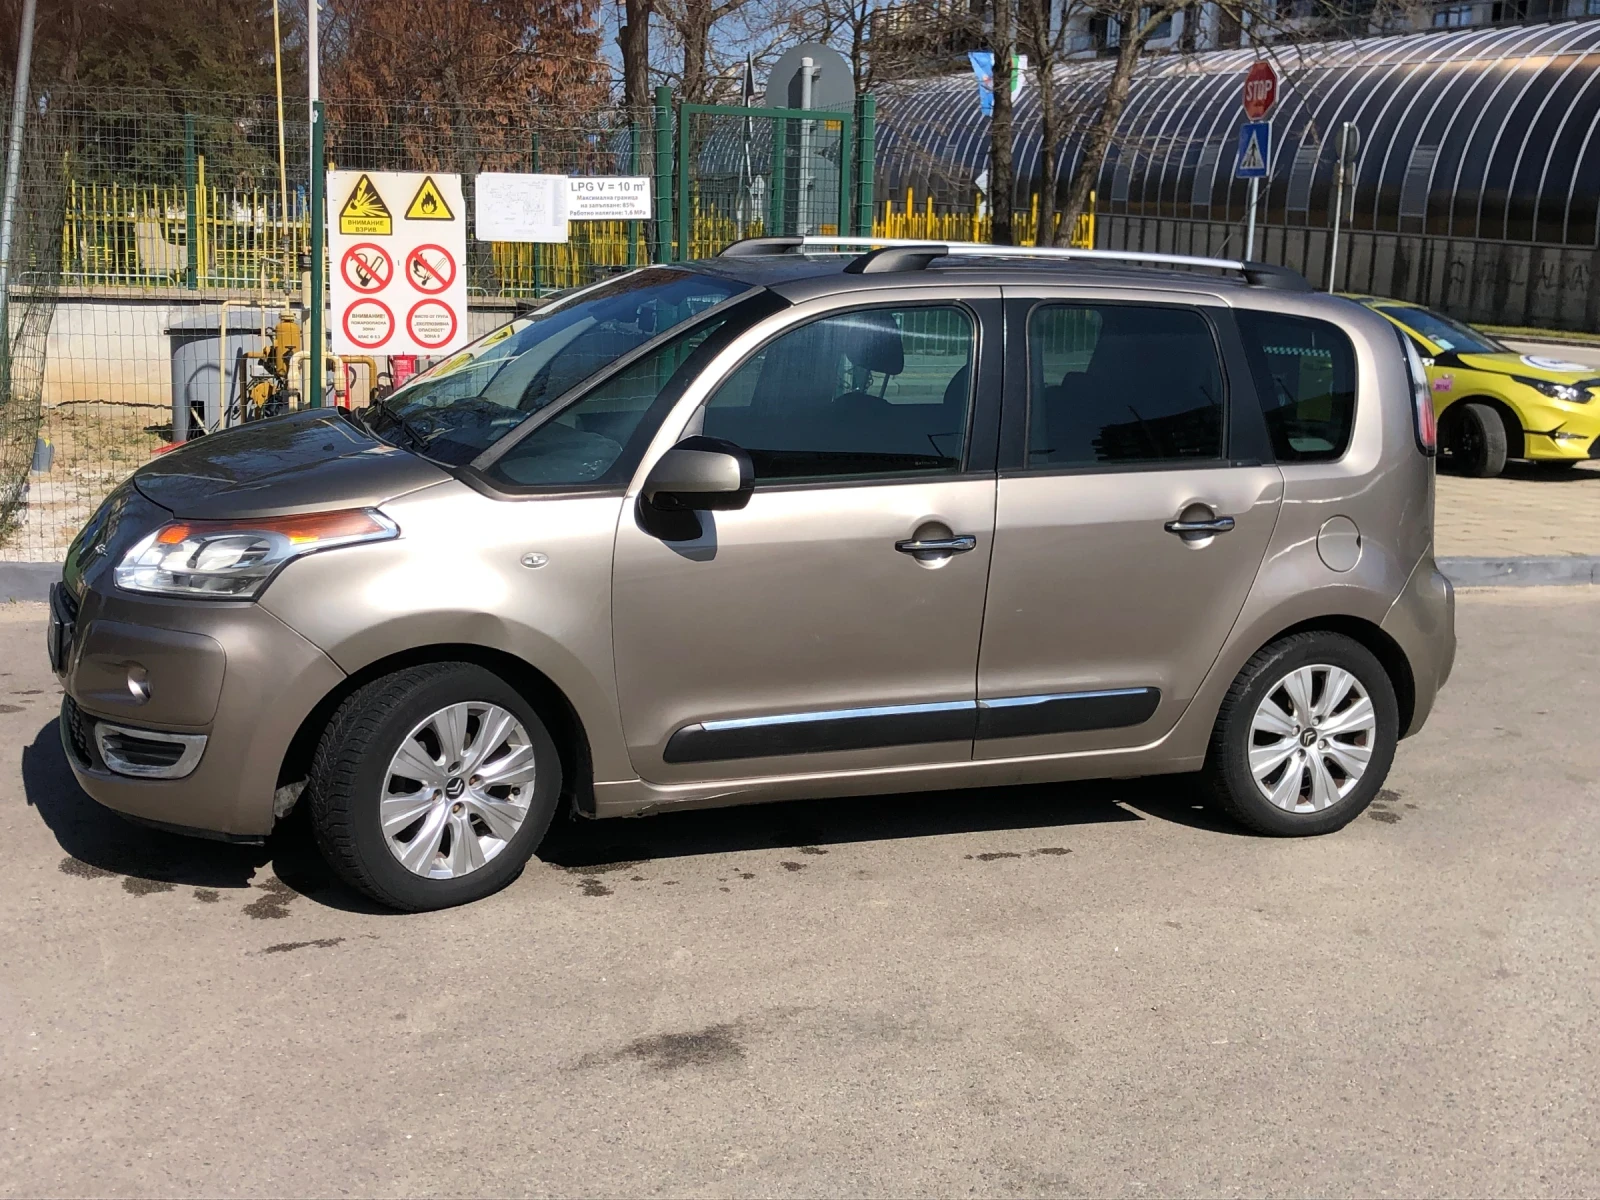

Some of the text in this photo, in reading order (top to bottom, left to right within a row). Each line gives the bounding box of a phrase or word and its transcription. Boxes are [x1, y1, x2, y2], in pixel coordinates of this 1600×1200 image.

[1246, 79, 1273, 101] STOP
[570, 182, 594, 192] LPG
[597, 182, 605, 191] V
[618, 181, 630, 191] 10
[347, 219, 385, 227] ВНИМАНИЕ
